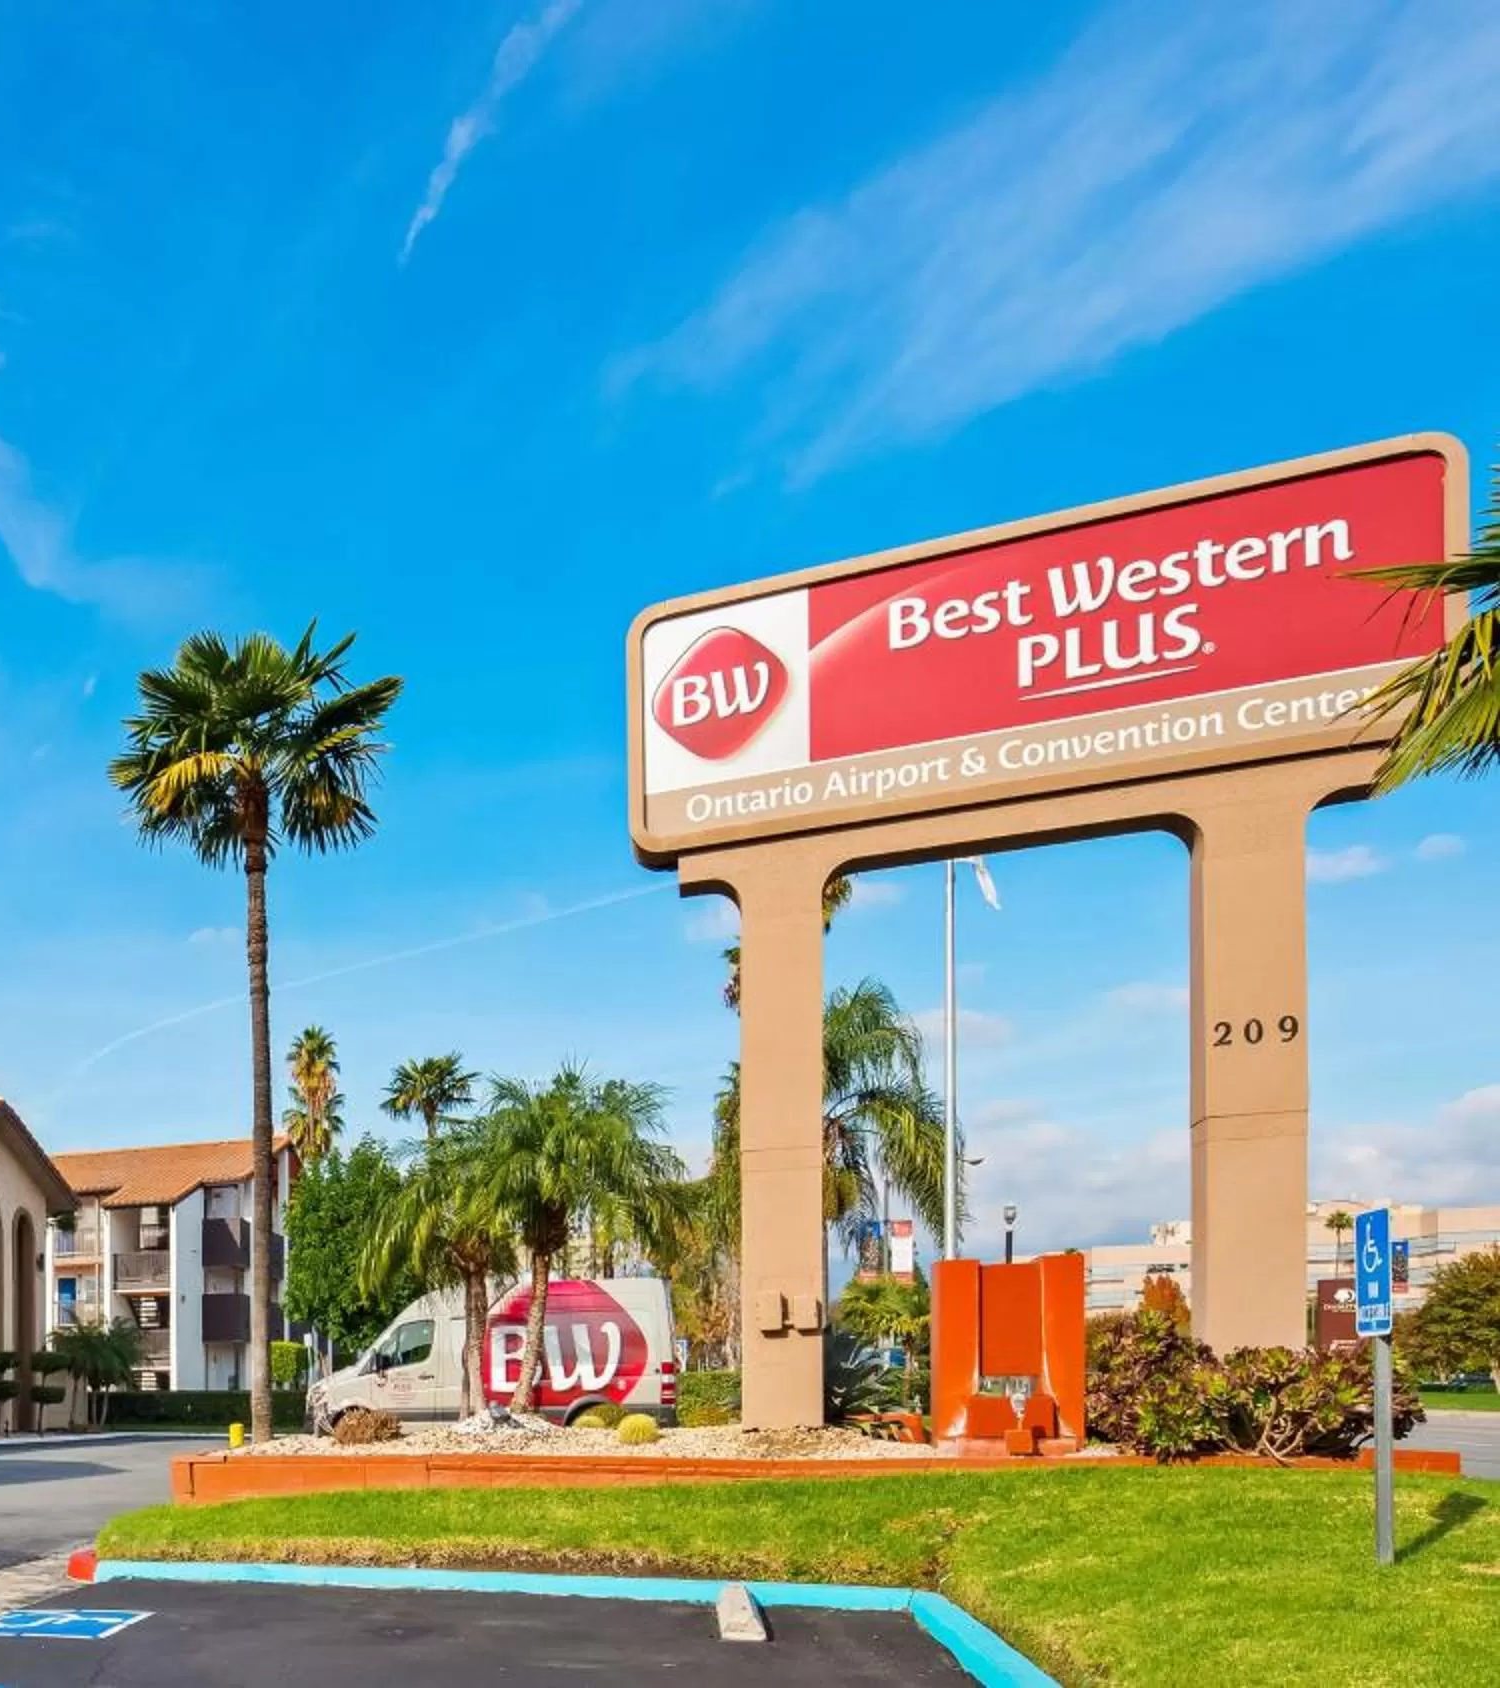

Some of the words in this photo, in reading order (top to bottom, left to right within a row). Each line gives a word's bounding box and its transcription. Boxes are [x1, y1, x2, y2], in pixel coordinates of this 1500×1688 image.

[888, 579, 1034, 650] Best
[1047, 519, 1355, 618] Western
[672, 661, 769, 727] BW
[686, 778, 813, 822] Ontario
[821, 756, 950, 799] Airport
[960, 747, 988, 777] &
[998, 712, 1224, 769] Convention
[1213, 1015, 1299, 1047] 209
